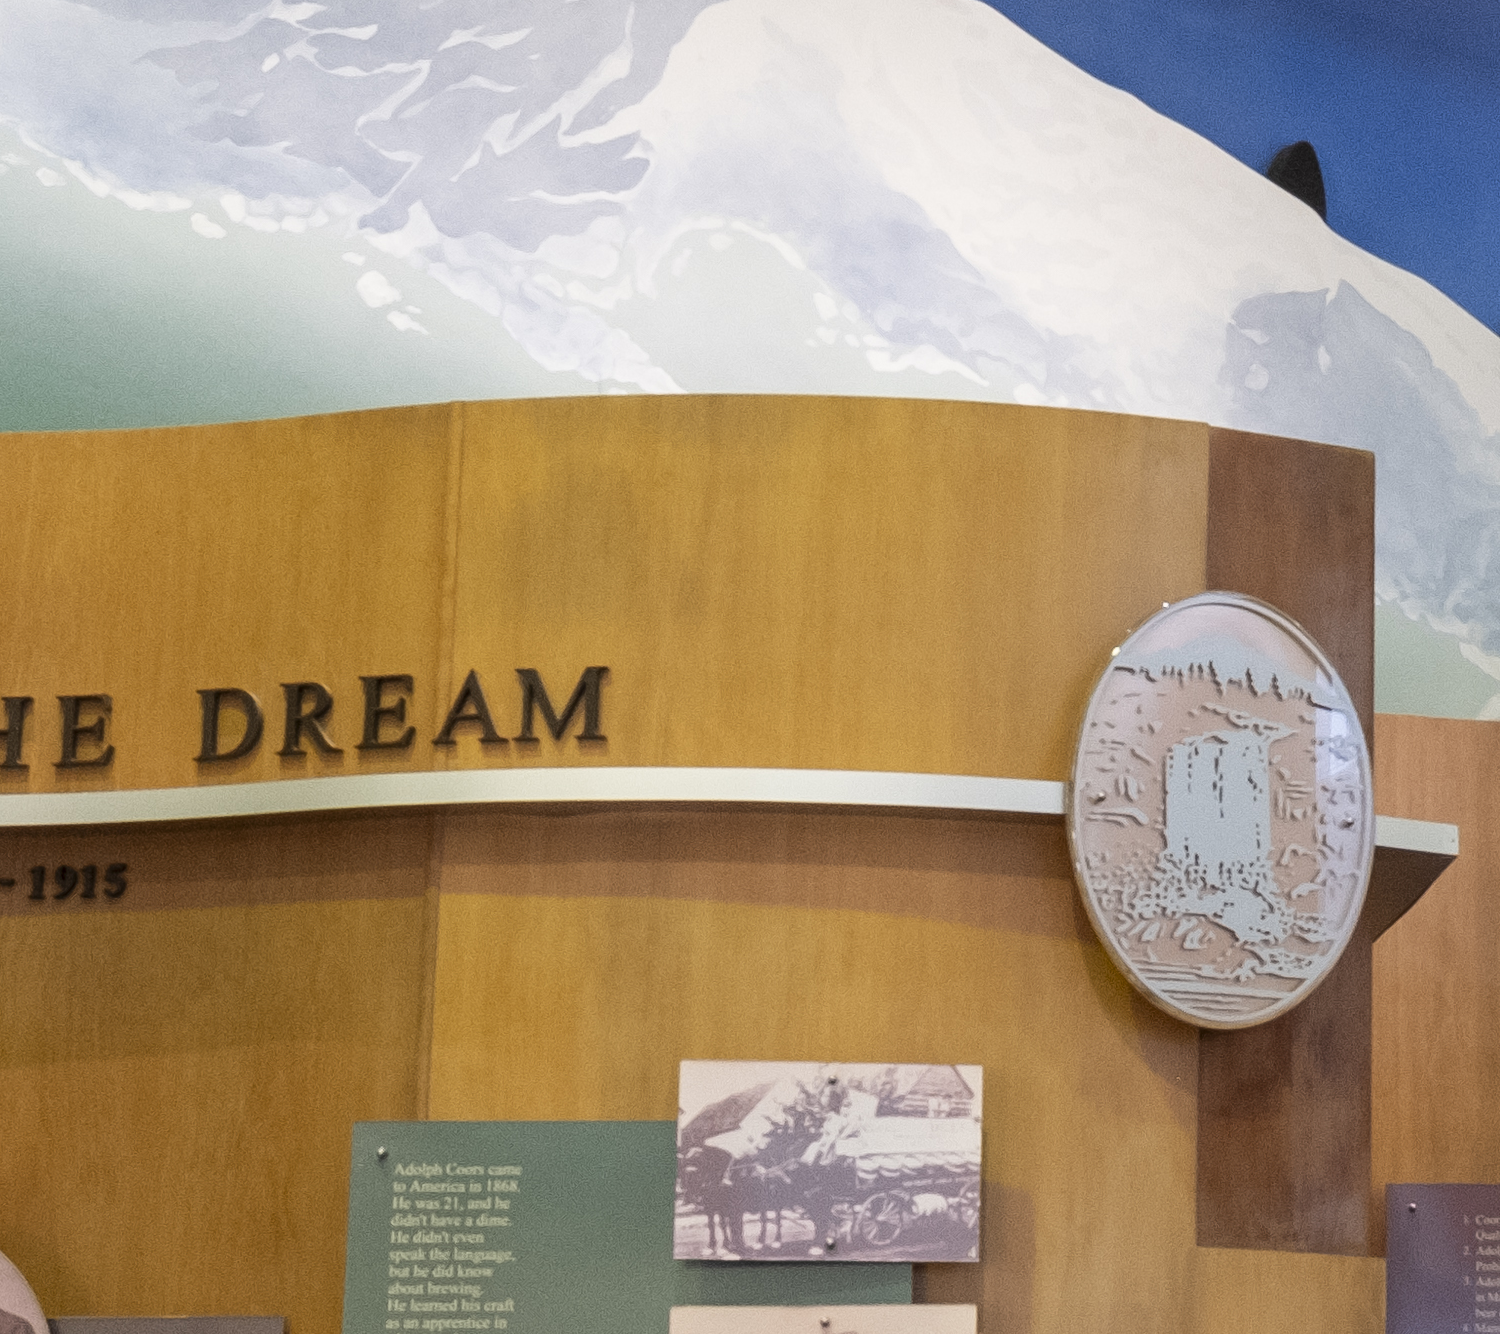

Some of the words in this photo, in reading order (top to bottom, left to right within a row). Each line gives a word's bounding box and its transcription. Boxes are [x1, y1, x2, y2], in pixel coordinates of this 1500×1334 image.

[196, 666, 609, 763] DREAM
[393, 1180, 406, 1192] to
[410, 1180, 465, 1192] America
[469, 1180, 482, 1192] in
[487, 1180, 520, 1192] 1868.
[393, 1197, 411, 1209] He
[416, 1200, 440, 1209] was
[444, 1197, 463, 1210] 21,
[467, 1197, 492, 1209] and
[495, 1197, 510, 1209] he
